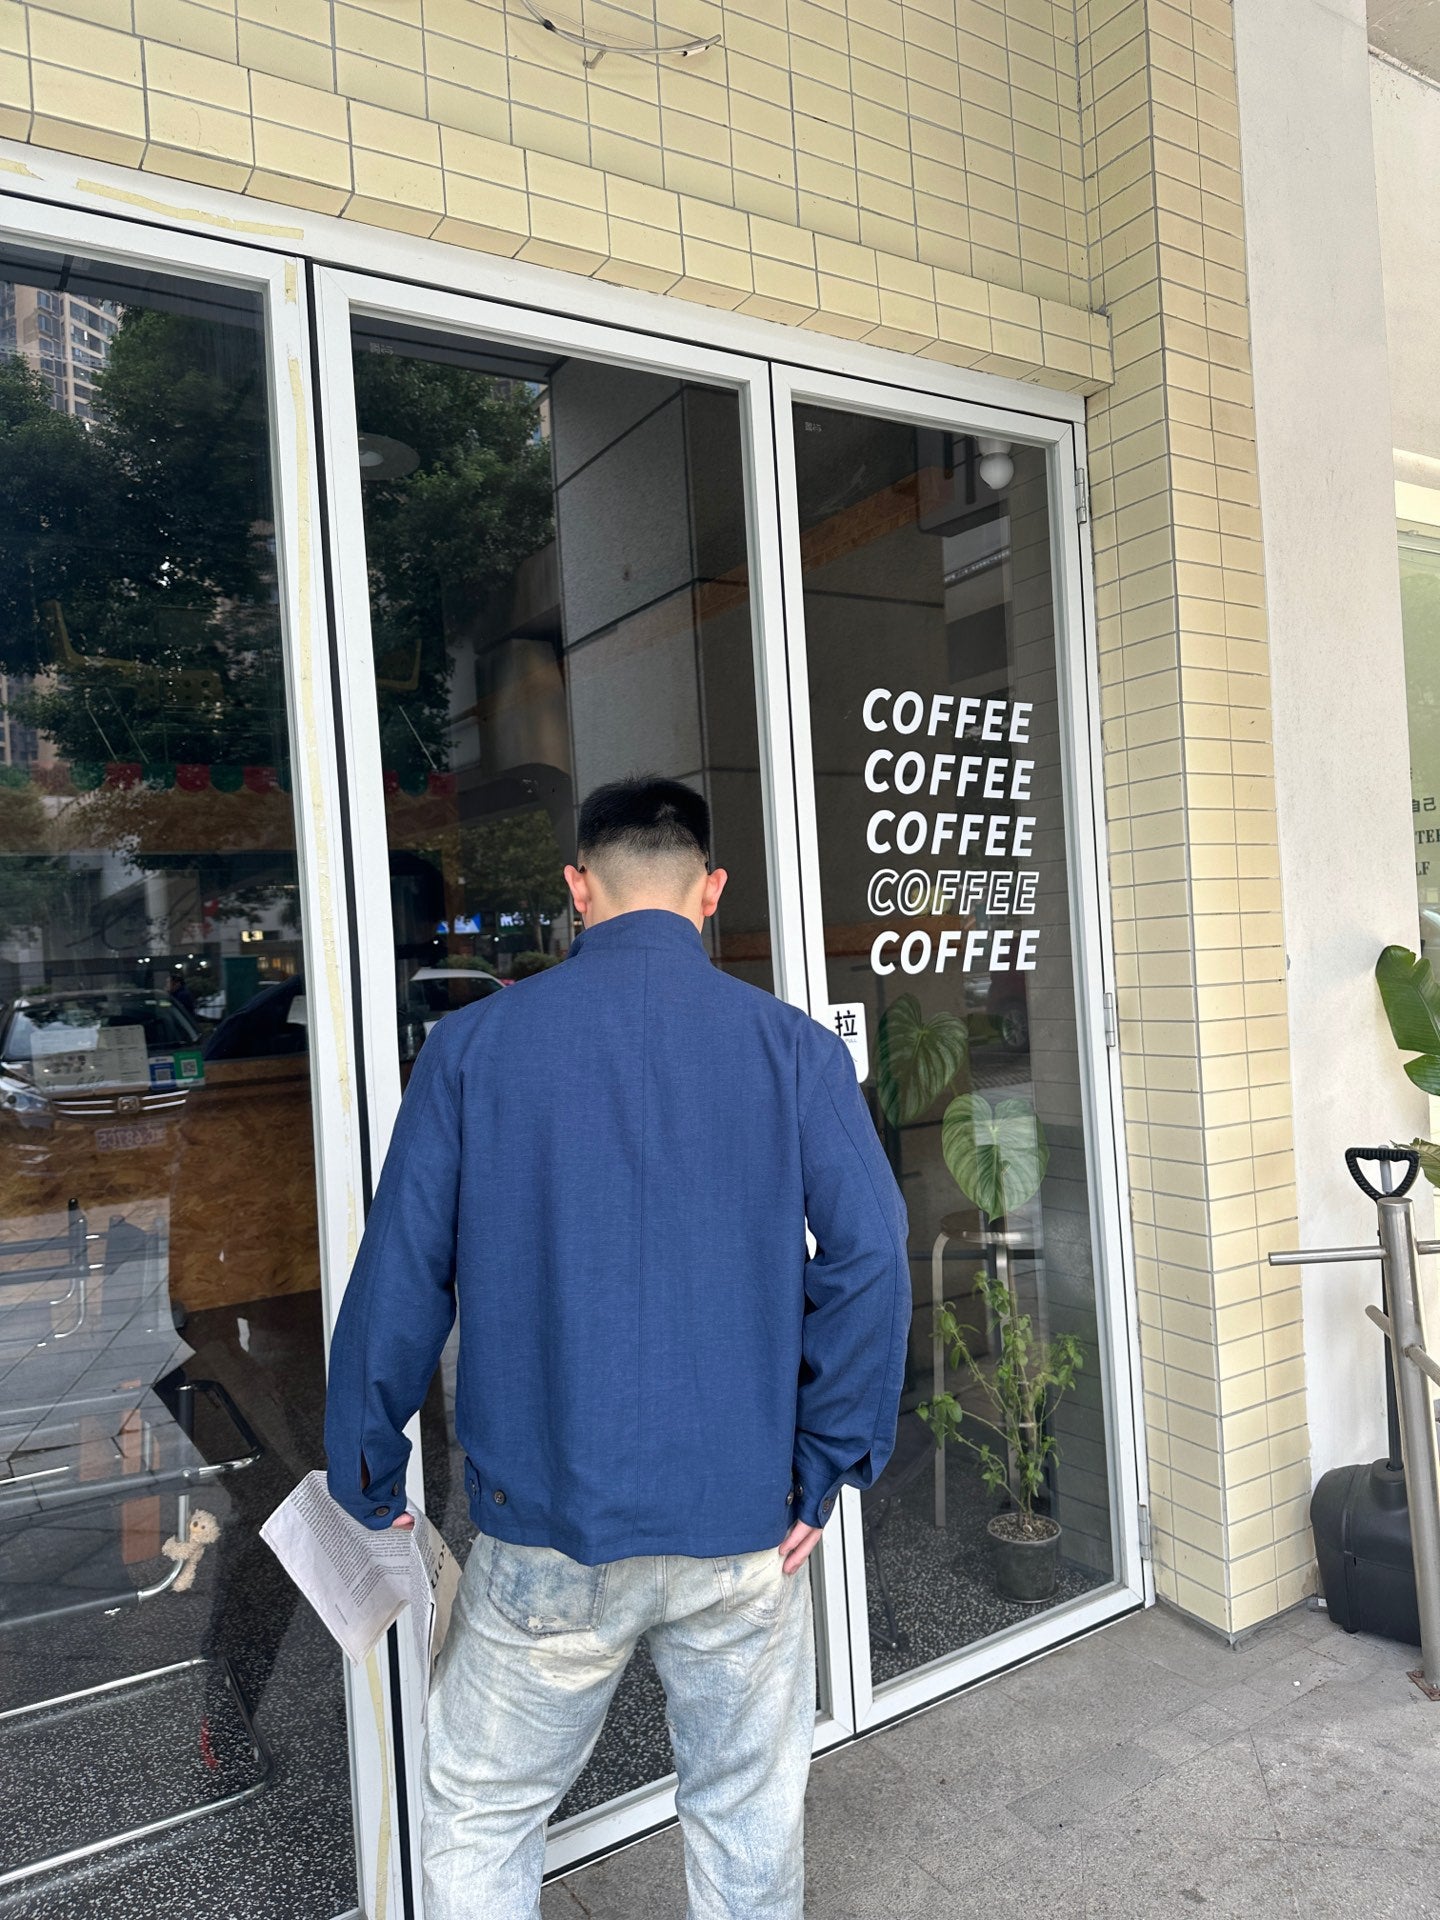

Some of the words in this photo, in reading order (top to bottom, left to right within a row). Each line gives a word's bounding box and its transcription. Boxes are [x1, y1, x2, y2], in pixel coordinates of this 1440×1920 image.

[863, 688, 1033, 743] COFFEE
[865, 749, 1035, 800] COFFEE
[866, 809, 1036, 856] COFFEE
[867, 868, 1039, 916] COFFEE
[871, 930, 1040, 975] COFFEE
[834, 1010, 857, 1036] 拉
